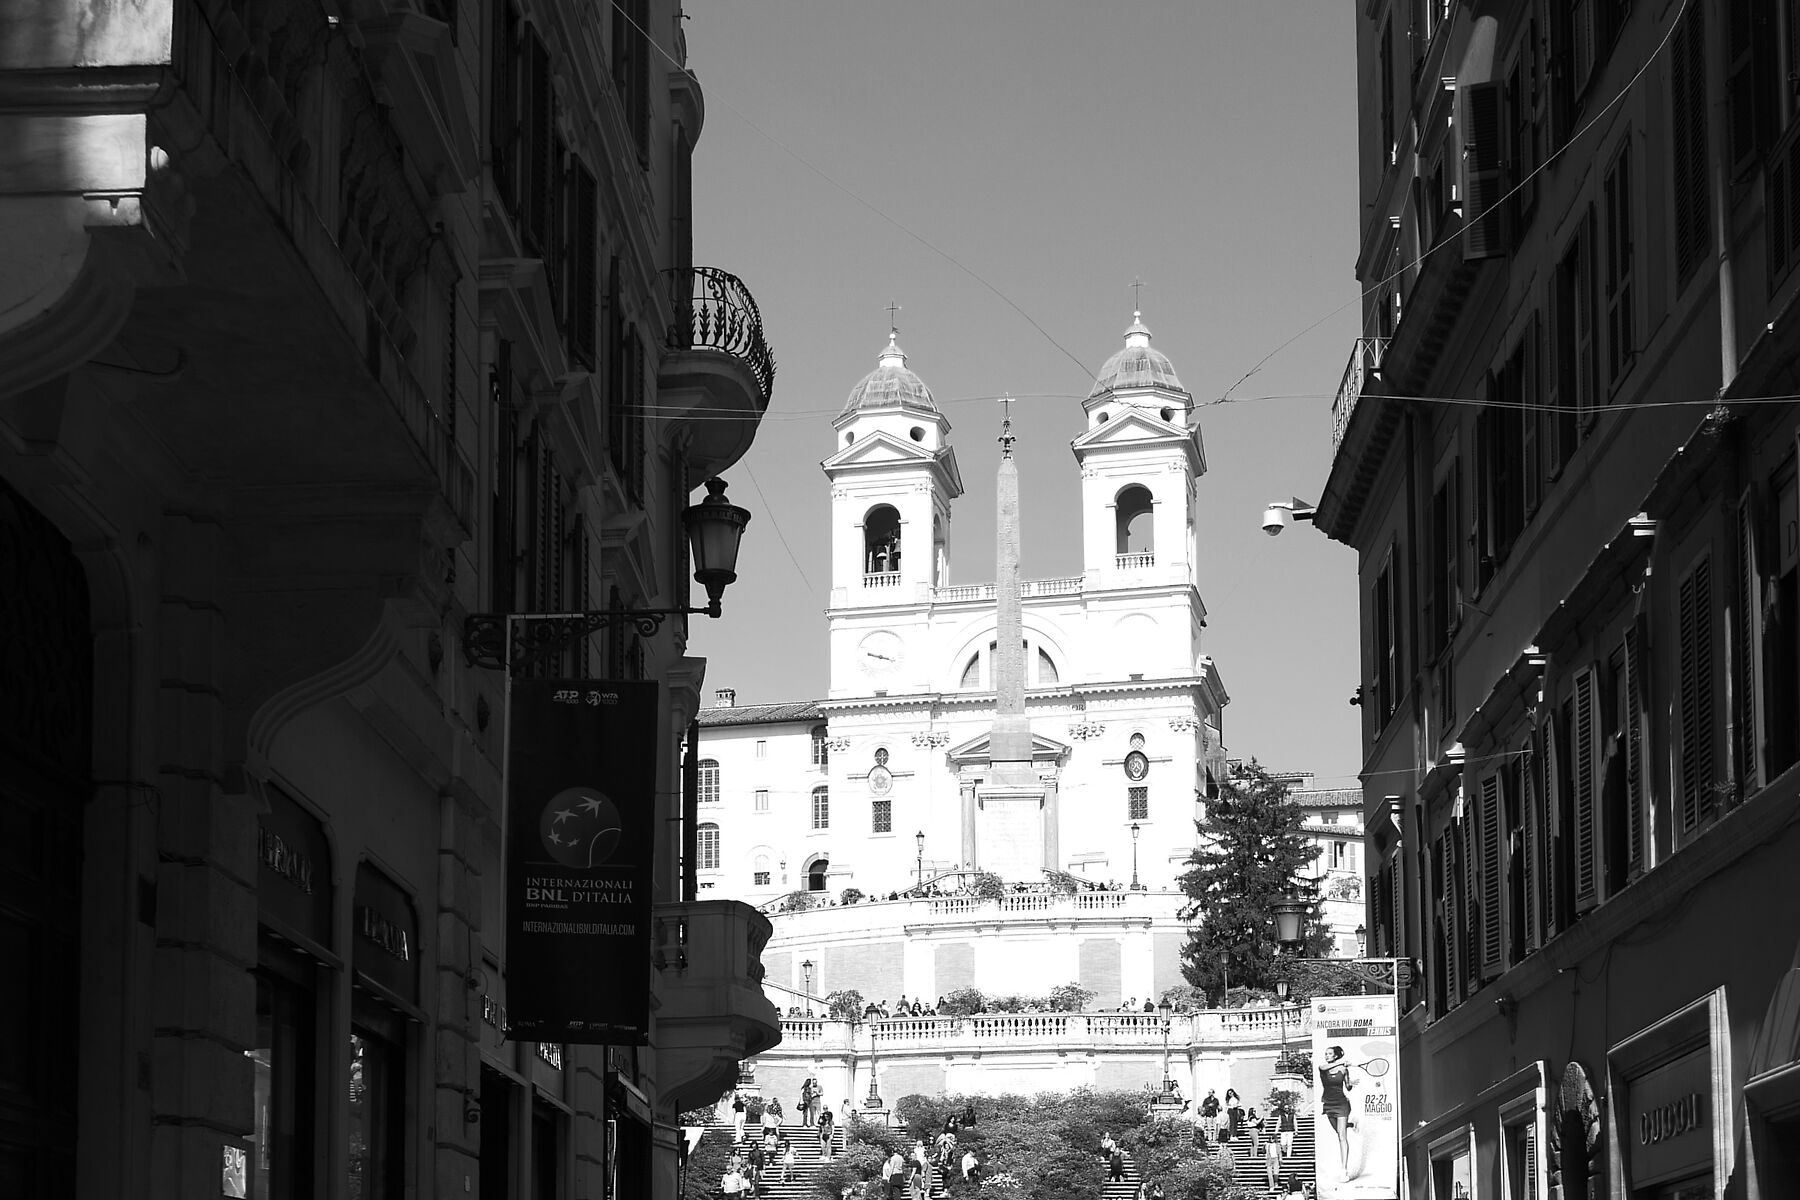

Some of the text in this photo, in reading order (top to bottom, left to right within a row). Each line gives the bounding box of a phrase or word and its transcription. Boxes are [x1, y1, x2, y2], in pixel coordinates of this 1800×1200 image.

[552, 690, 579, 699] ATP
[526, 877, 633, 889] INTERNAZIONALI
[526, 888, 633, 904] BNL D'ITALIA
[522, 921, 636, 936] INTERNAZIONALIBNLDITALIA.COM
[1316, 1020, 1340, 1029] ANCORA
[1353, 1019, 1372, 1028] ROMA
[1367, 1027, 1392, 1036] TENNIS
[1365, 1094, 1387, 1104] 02-21
[1364, 1103, 1393, 1113] MAGGIO
